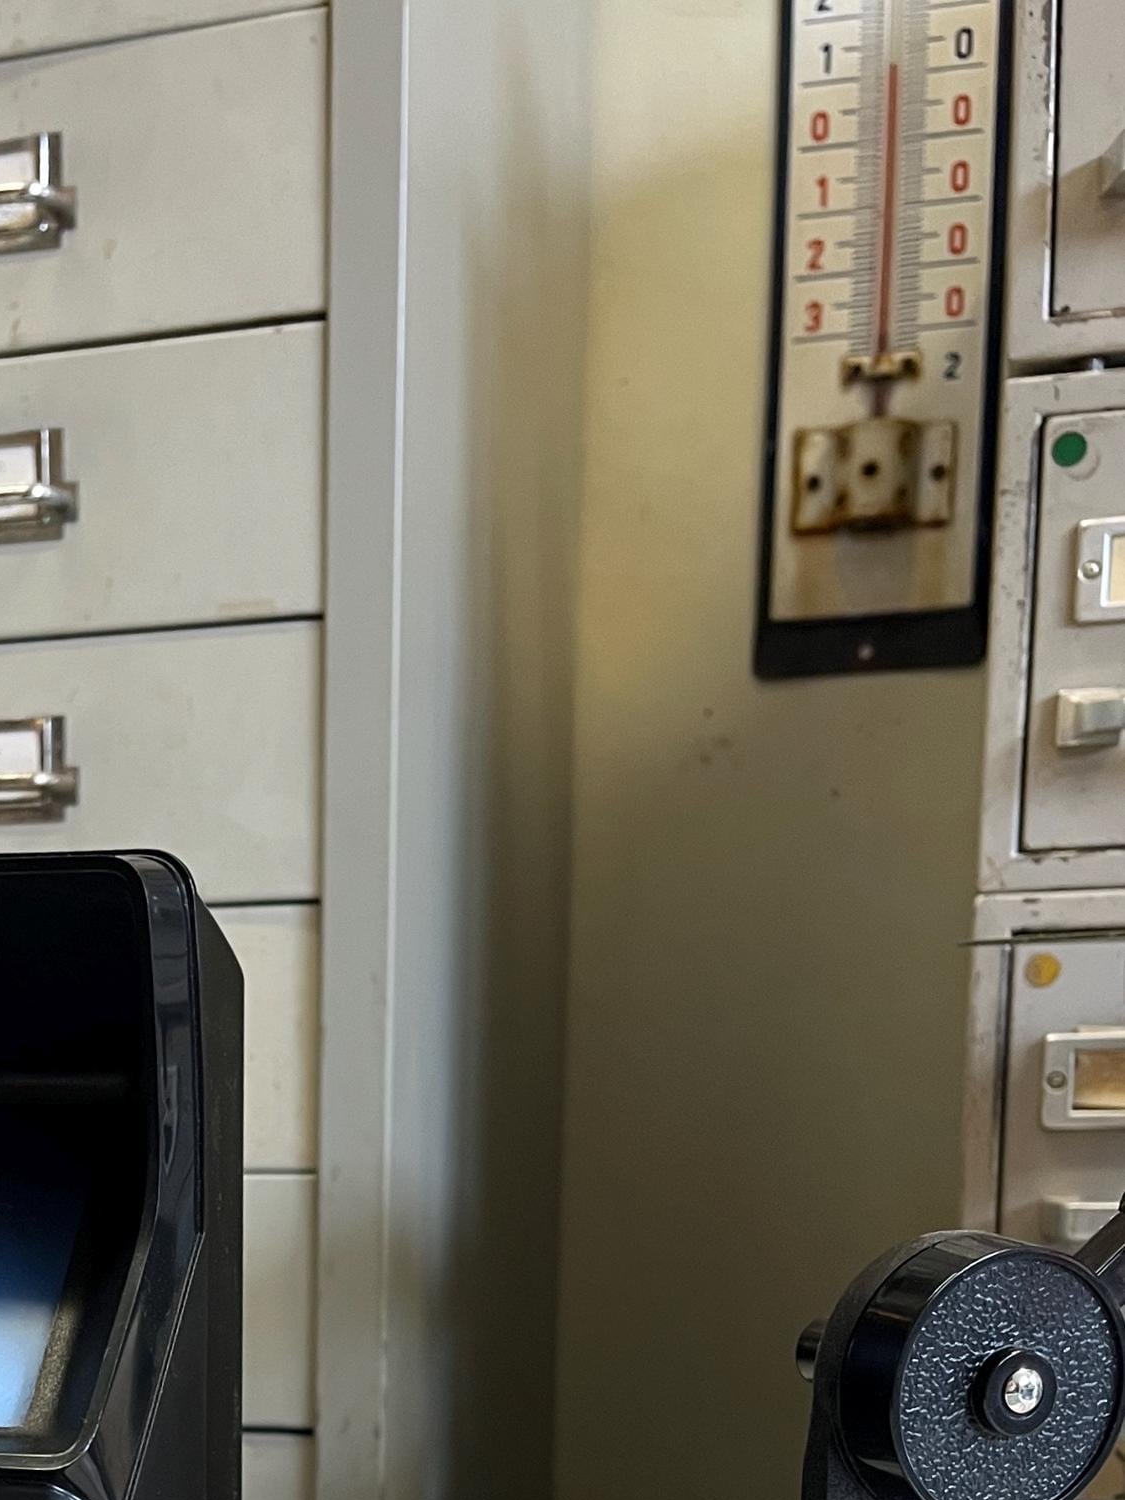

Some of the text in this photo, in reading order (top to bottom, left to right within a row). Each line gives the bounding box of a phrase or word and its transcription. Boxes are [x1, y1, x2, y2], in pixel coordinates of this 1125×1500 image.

[954, 27, 974, 60] 0
[810, 94, 972, 142] 0 0
[815, 160, 970, 208] 1 0
[805, 223, 968, 271] 2 0
[804, 286, 966, 333] 3 0
[943, 352, 961, 380] 2
